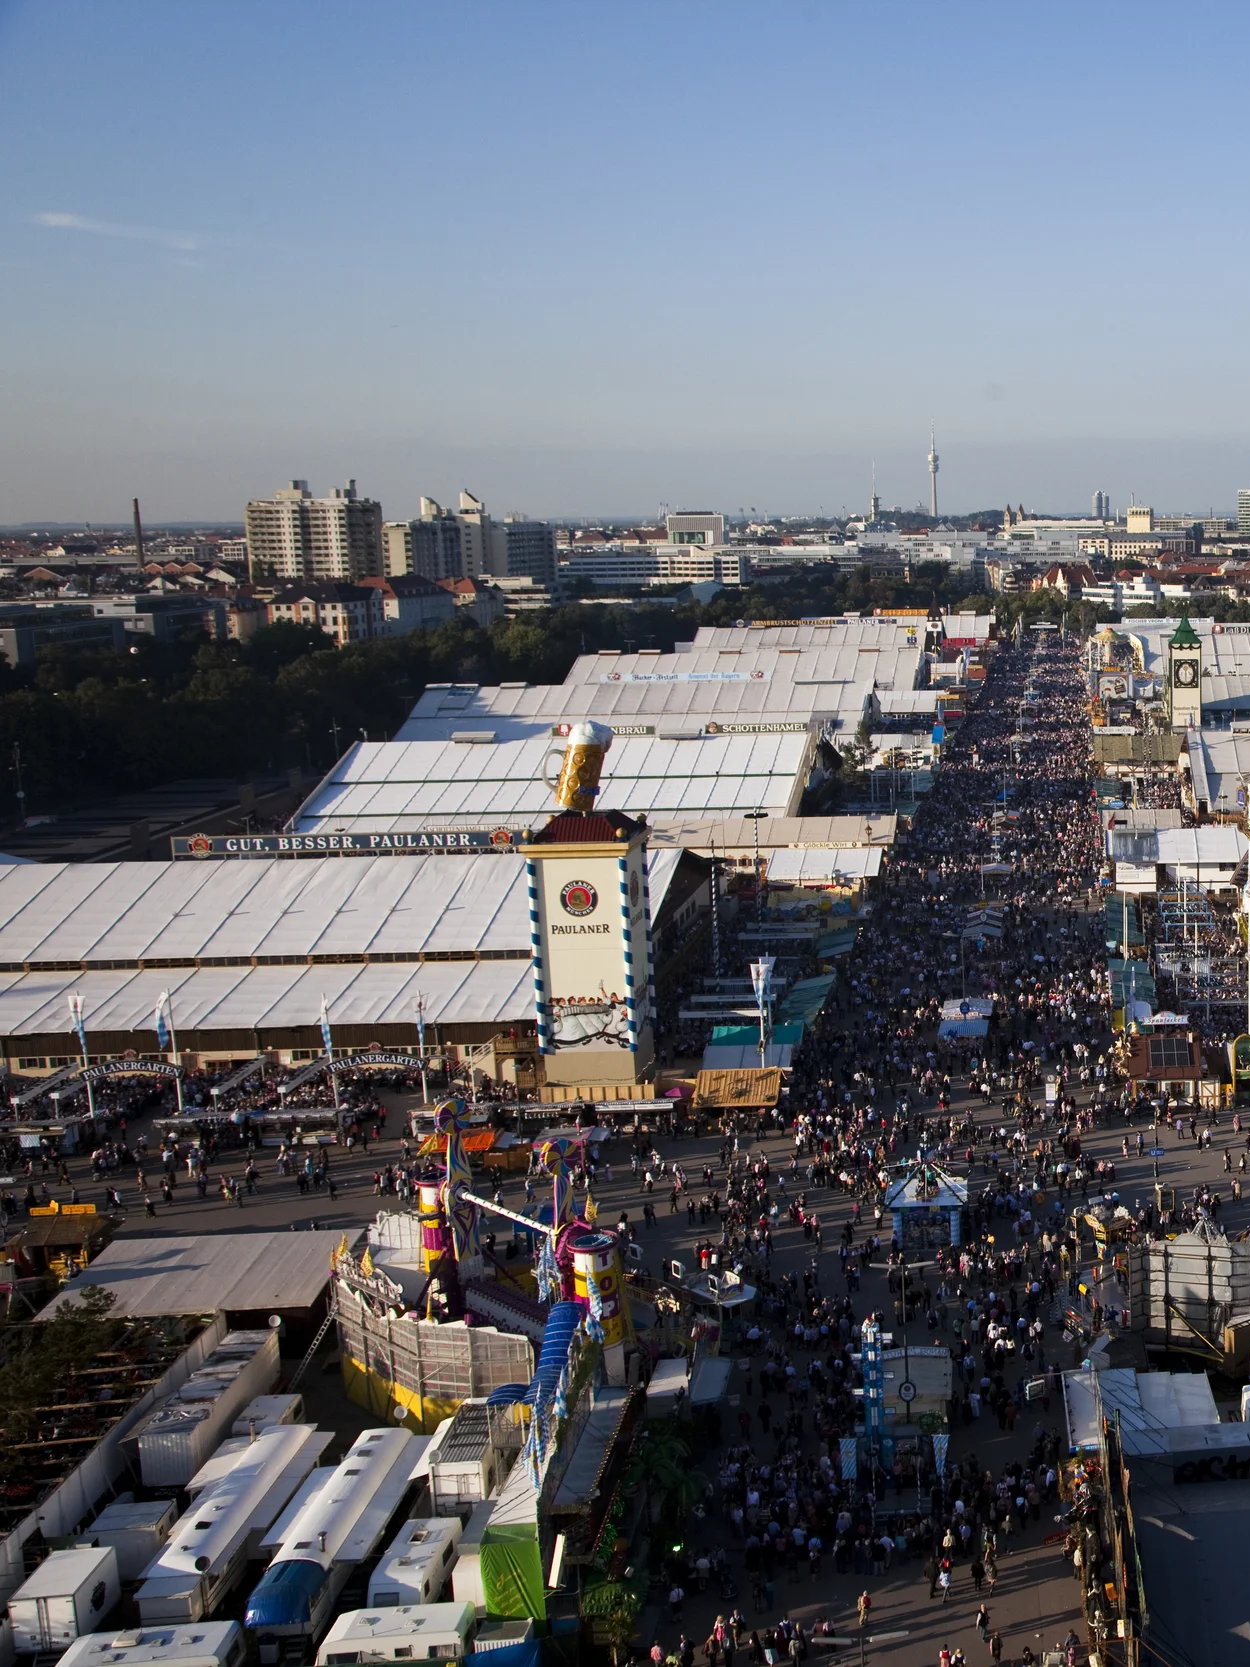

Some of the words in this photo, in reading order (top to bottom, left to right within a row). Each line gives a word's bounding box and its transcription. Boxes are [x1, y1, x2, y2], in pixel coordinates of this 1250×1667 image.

[722, 723, 806, 732] SCHOTTENHAMEL
[226, 839, 269, 851] GUT,
[279, 836, 361, 850] BESSER,
[370, 833, 477, 847] PAULANER.
[562, 882, 595, 895] PAULANER
[551, 924, 610, 934] PAULANER
[83, 1062, 181, 1080] PAULANERGARTEN
[329, 1054, 424, 1073] PAULANERGARTEN
